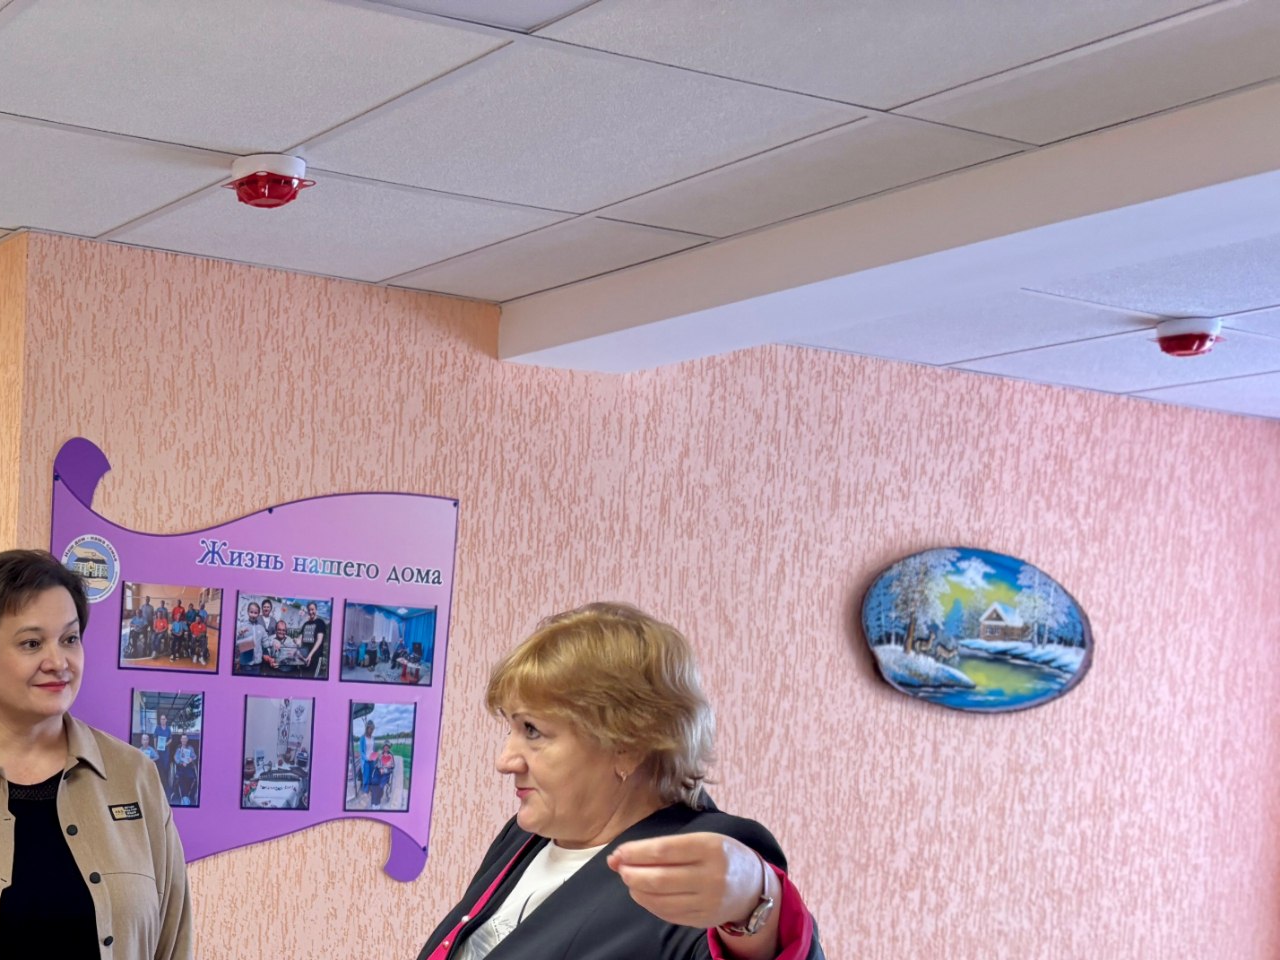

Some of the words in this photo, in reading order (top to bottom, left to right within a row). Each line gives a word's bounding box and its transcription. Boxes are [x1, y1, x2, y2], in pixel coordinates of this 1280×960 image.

[197, 539, 285, 571] Жизнь
[292, 556, 380, 580] нашего
[386, 565, 444, 586] дома
